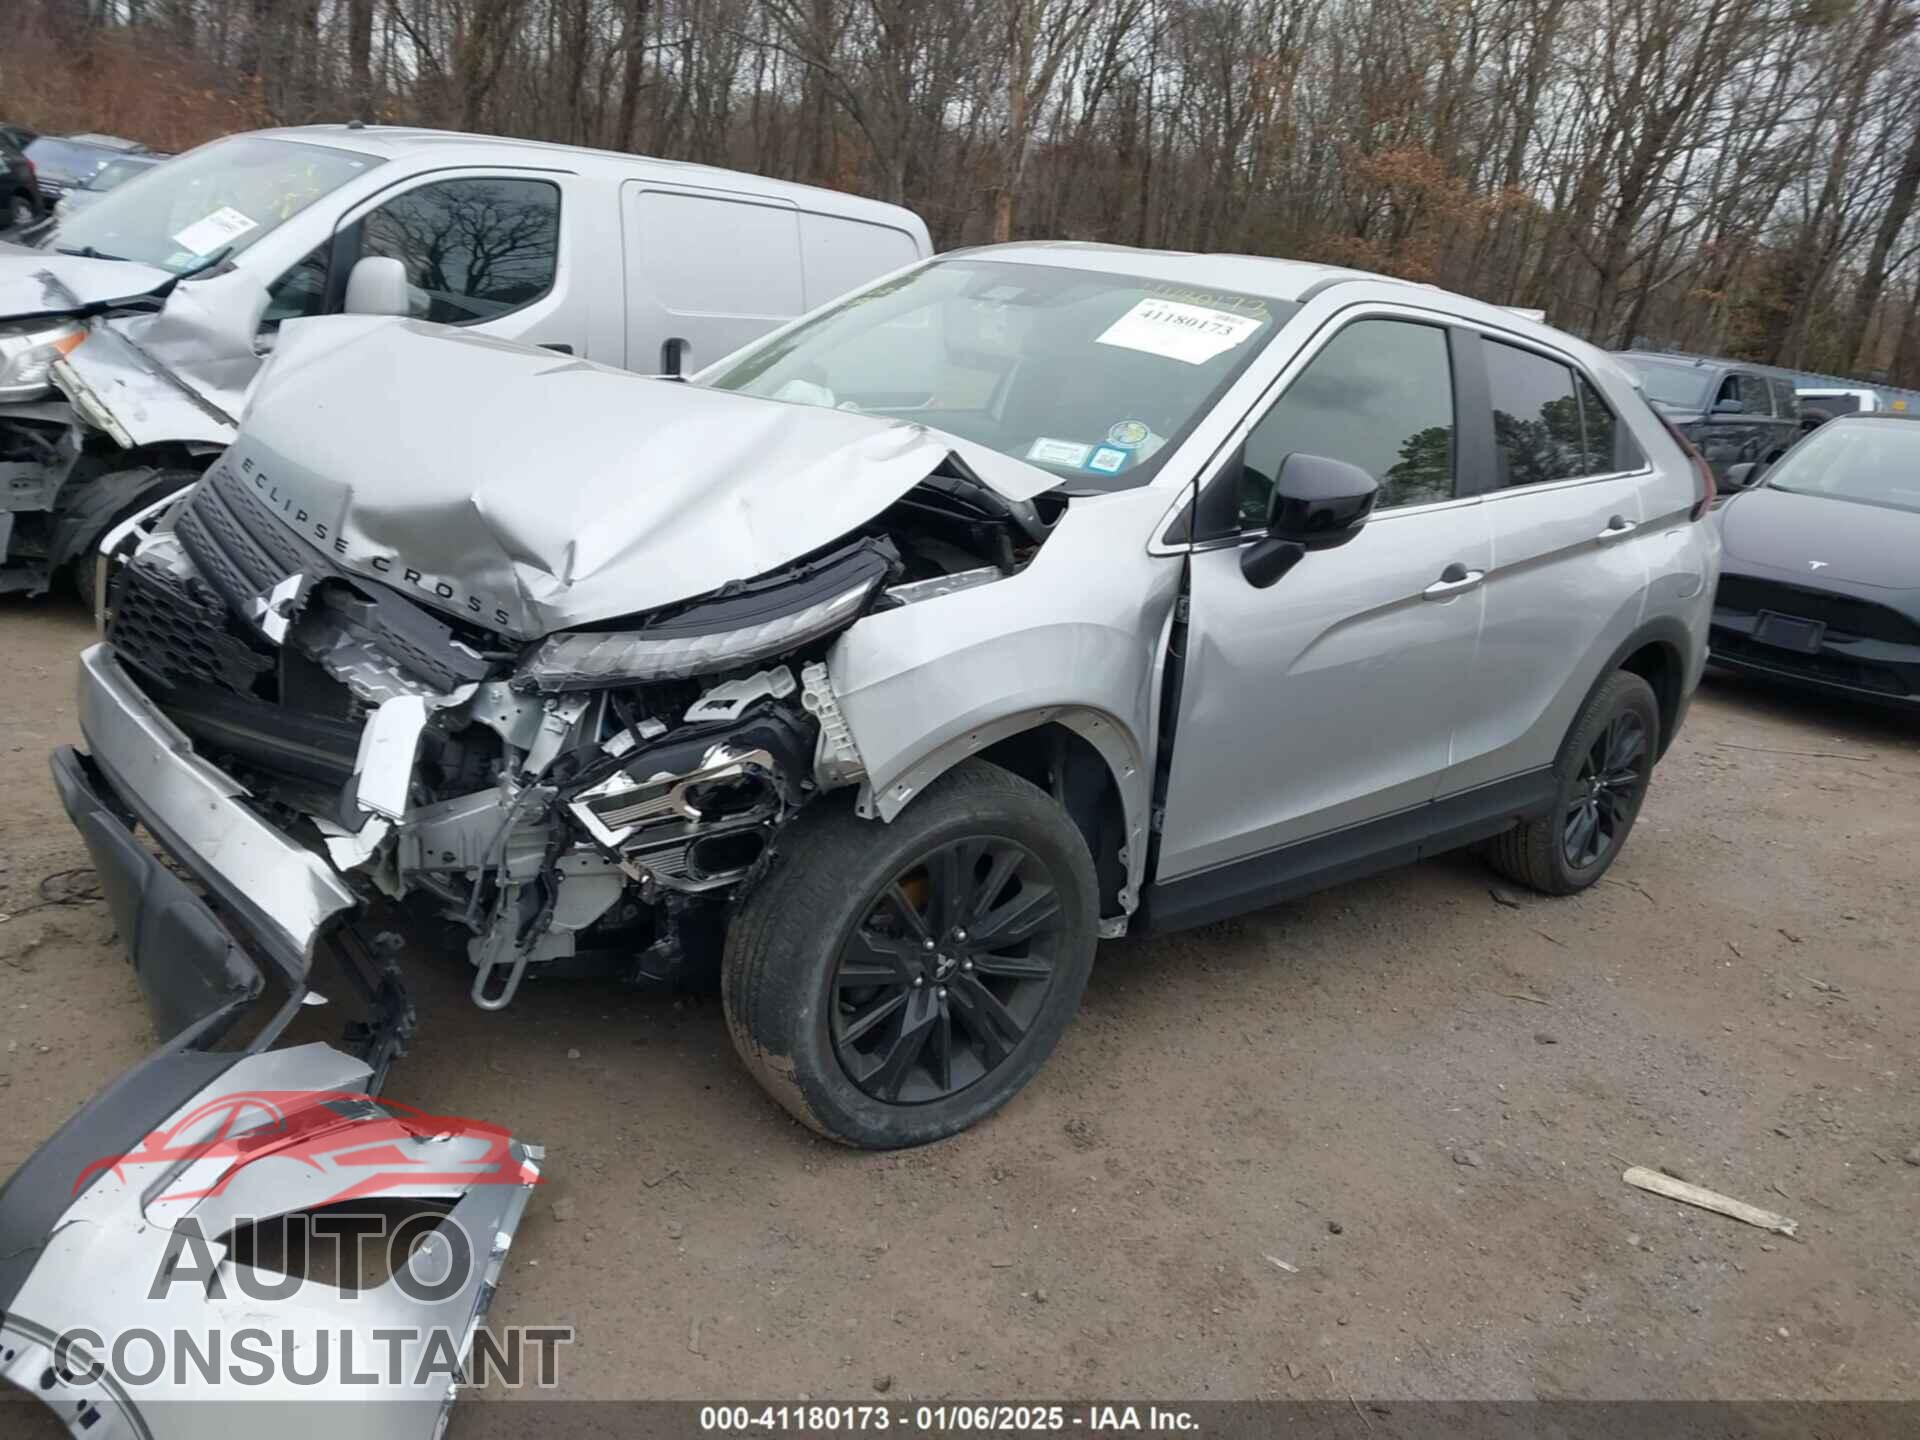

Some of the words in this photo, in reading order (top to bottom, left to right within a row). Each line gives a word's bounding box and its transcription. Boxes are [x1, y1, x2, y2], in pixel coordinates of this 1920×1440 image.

[1141, 309, 1234, 337] 41180173
[241, 457, 350, 554] ECLIPSE
[371, 556, 510, 626] CROSS
